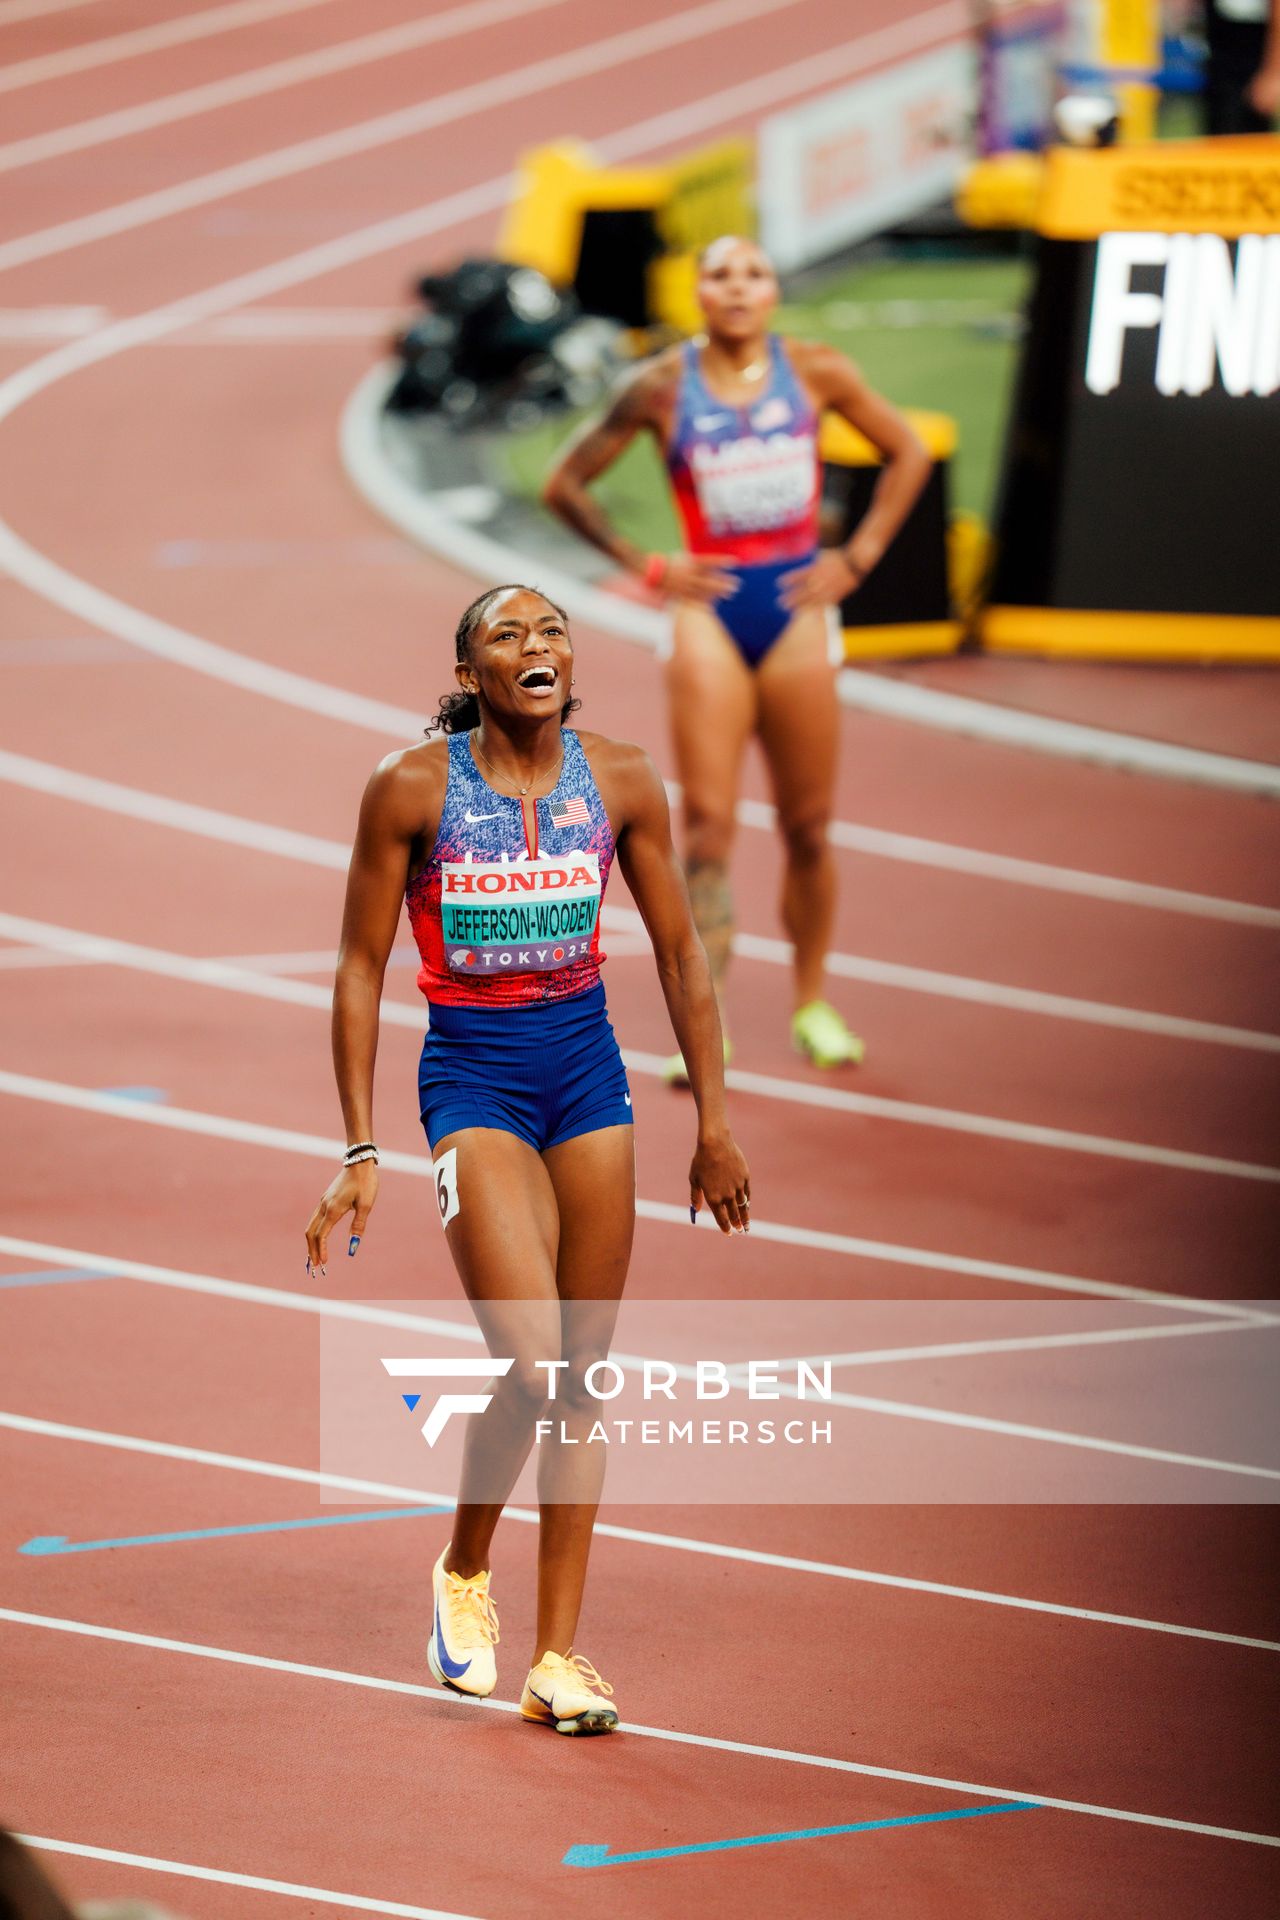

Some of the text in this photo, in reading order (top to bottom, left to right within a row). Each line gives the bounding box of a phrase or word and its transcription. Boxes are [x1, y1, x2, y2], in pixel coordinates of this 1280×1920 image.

[444, 867, 597, 894] HONDA
[448, 900, 596, 941] JEFFERSON-WOODEN
[437, 1167, 449, 1218] 6
